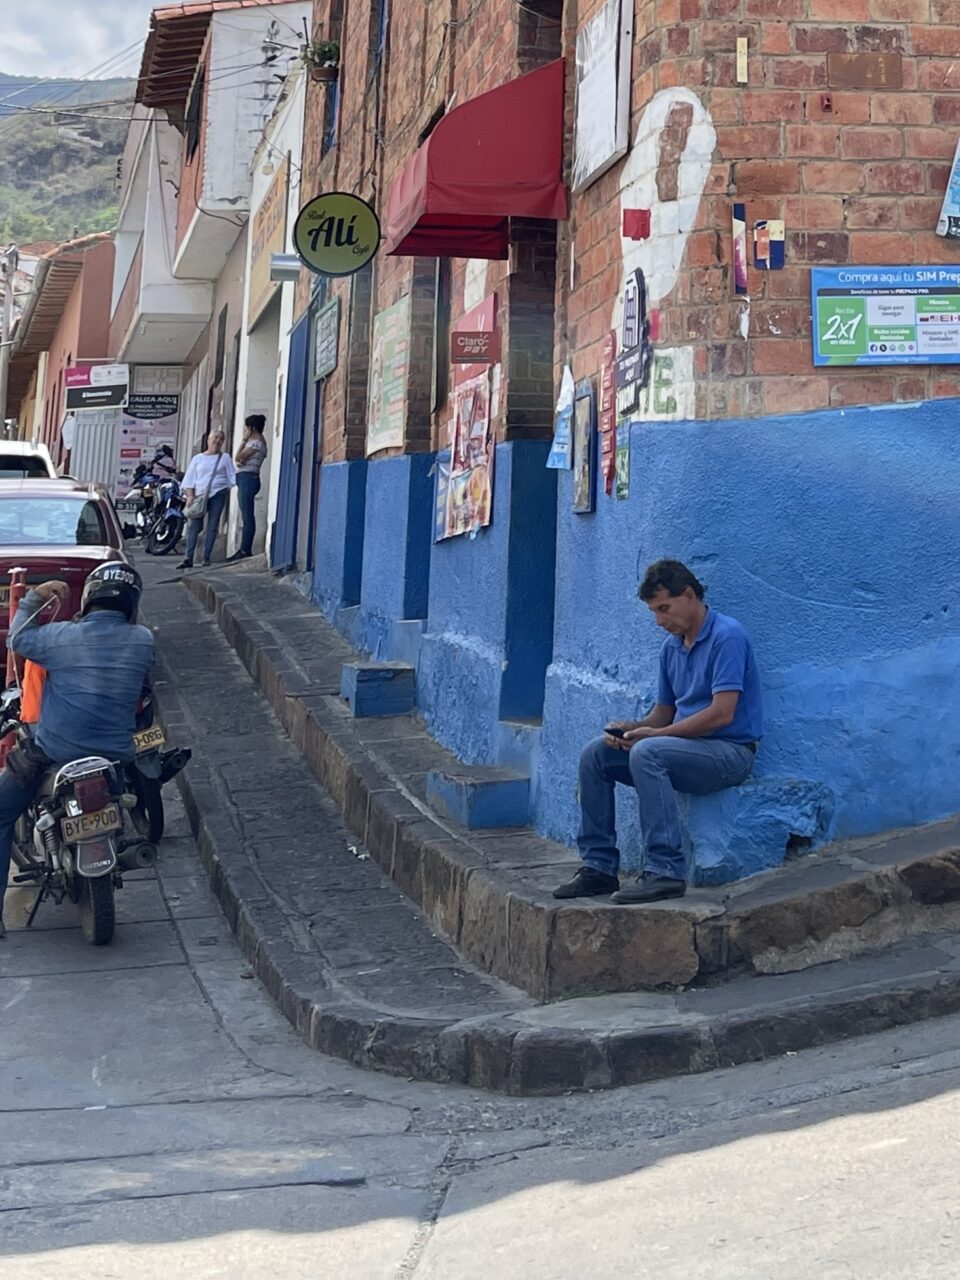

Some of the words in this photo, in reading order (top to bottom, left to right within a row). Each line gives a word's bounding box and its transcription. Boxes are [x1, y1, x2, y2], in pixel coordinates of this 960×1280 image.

[838, 272, 878, 284] Compra
[904, 272, 914, 281] tu
[916, 271, 936, 281] SIM
[822, 313, 863, 341] 2x1
[457, 334, 489, 346] Claro
